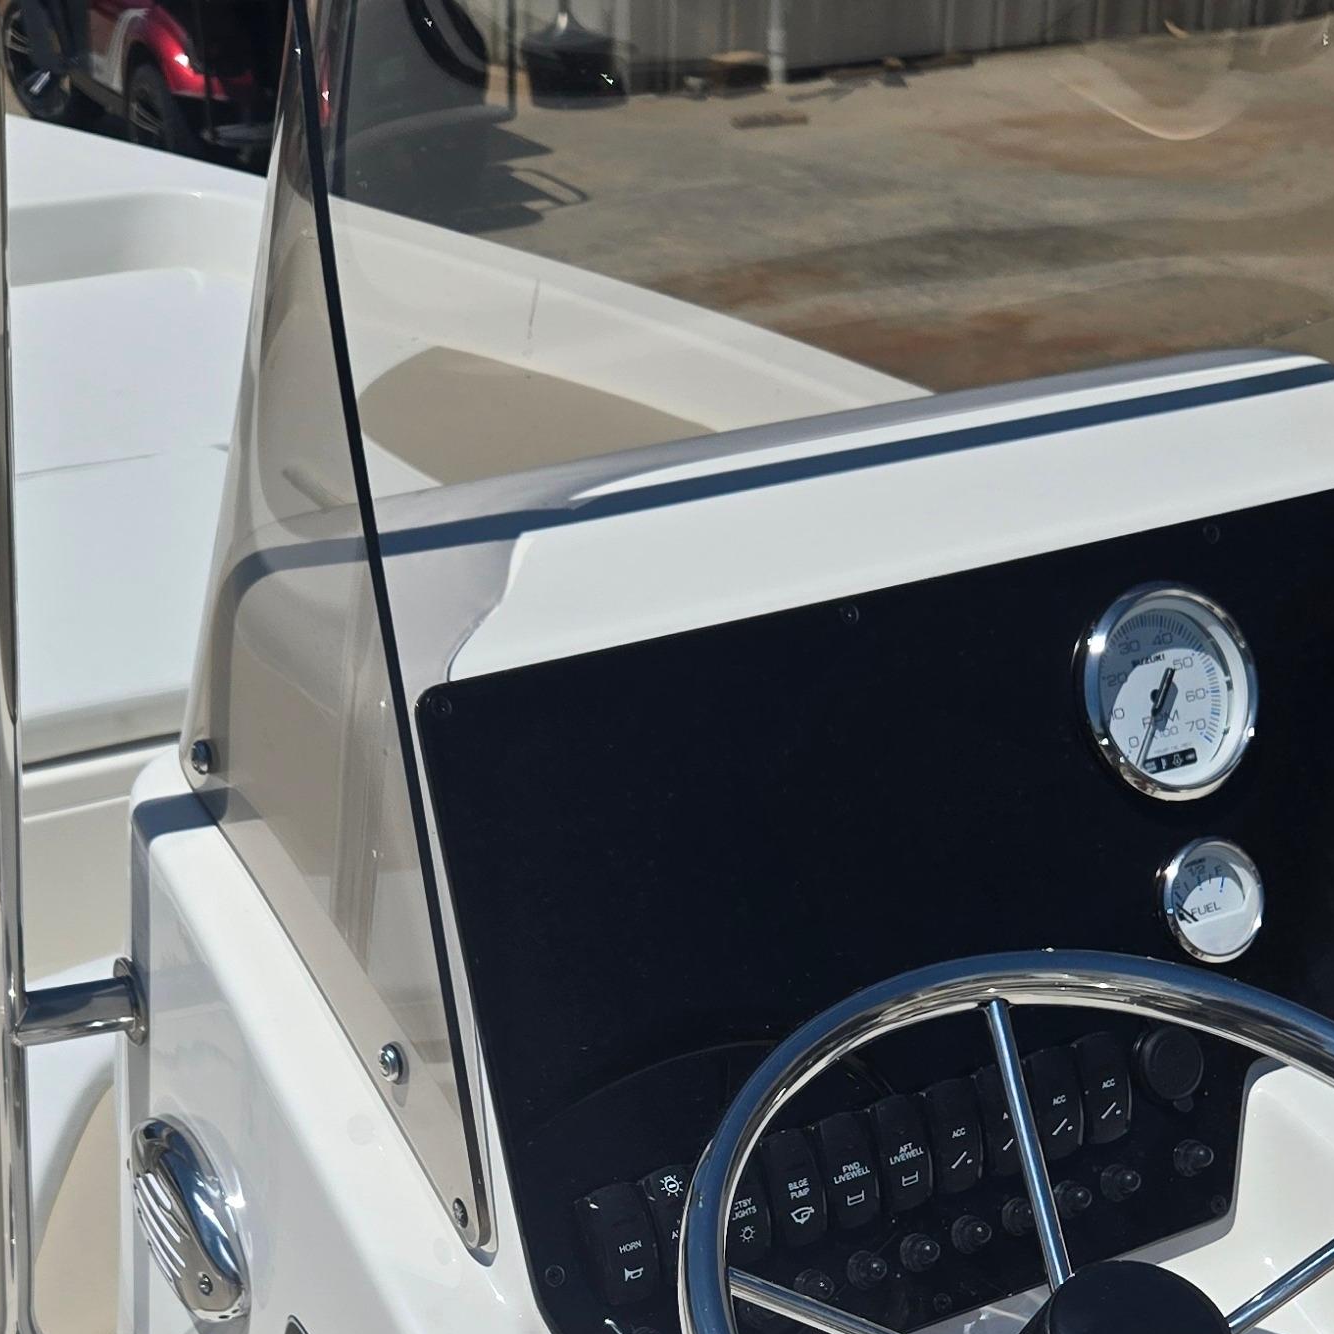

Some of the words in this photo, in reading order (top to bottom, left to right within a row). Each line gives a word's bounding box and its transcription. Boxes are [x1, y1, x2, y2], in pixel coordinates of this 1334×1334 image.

[1153, 632, 1173, 647] 40
[1118, 639, 1141, 655] 30
[1172, 656, 1194, 671] 50
[1107, 671, 1128, 687] 20
[1185, 687, 1206, 702] 60
[1185, 717, 1206, 732] 70
[1153, 726, 1179, 740] 100
[1128, 735, 1139, 748] 0
[1190, 901, 1221, 915] FUEL
[1102, 1078, 1115, 1089] ACC
[1053, 1095, 1066, 1106] ACC
[952, 1127, 965, 1138] ACC
[898, 1141, 913, 1154] AFT
[890, 1147, 923, 1165] LIVEWELL
[842, 1161, 860, 1173] FWD
[833, 1167, 870, 1184] LIVEWELL
[788, 1178, 809, 1191] BILGE
[790, 1188, 810, 1200] PUMP
[619, 1240, 642, 1254] HORN
